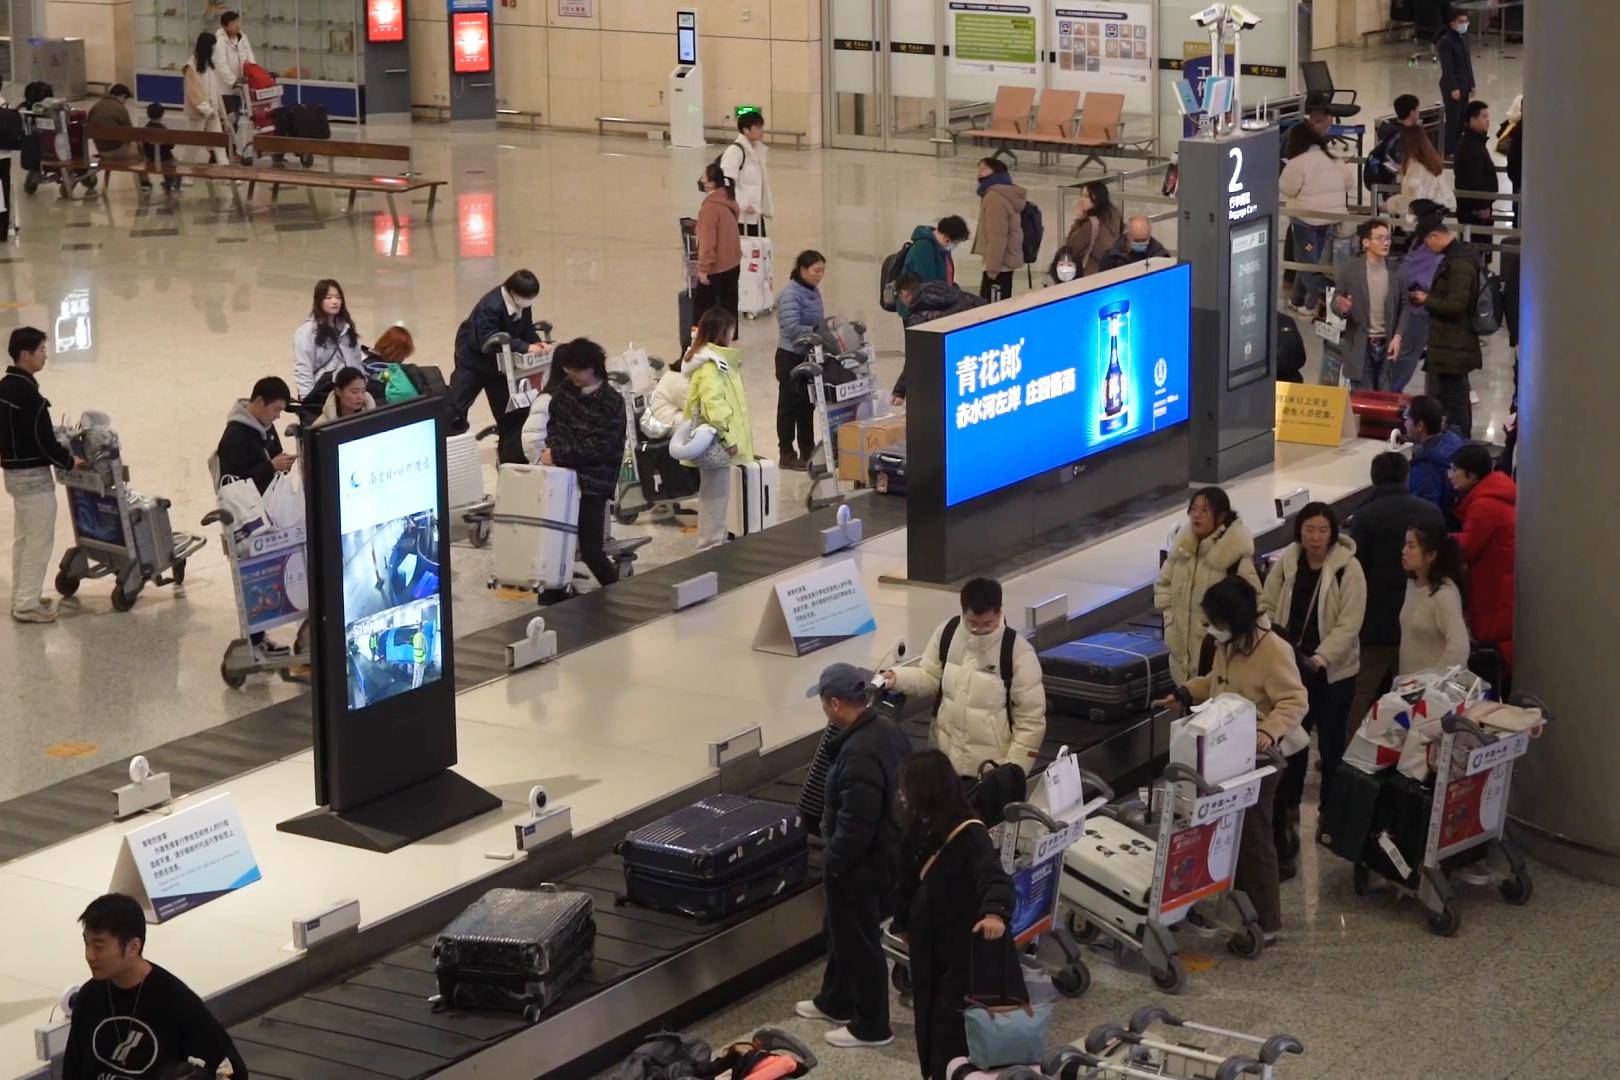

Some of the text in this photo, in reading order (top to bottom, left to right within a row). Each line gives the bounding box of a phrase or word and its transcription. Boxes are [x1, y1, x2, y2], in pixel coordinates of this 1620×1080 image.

[1229, 147, 1243, 192] 2
[956, 344, 1022, 396] 青花郎
[956, 385, 1022, 429] 赤水河左岸
